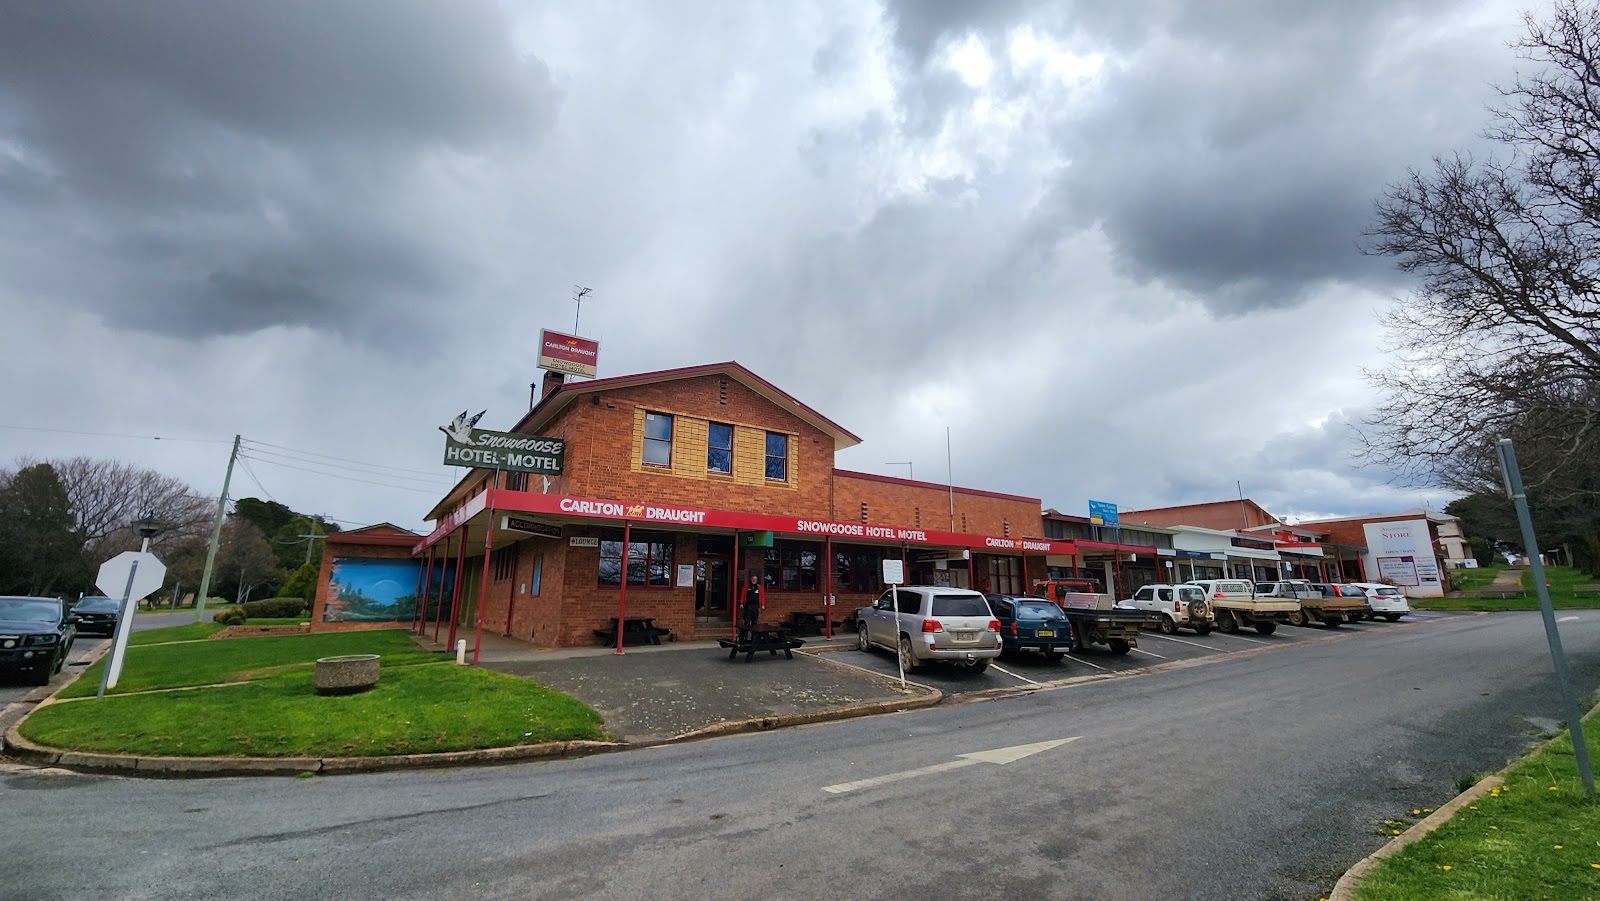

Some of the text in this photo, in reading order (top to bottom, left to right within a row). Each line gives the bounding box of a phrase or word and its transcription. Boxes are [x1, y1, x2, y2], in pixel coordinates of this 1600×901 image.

[545, 341, 570, 352] CARLTON
[570, 347, 596, 357] DRAUGHT
[550, 362, 585, 374] HOTEL MOTEL
[552, 358, 585, 369] SNOWGOOSE
[476, 433, 563, 455] SNOWGOOSE
[560, 498, 706, 523] CARLTON DRAUGHT
[510, 519, 560, 535] ACCOMMODATION
[797, 520, 927, 541] SNOWGOOSE HOTEL MOTEL
[575, 538, 598, 546] LOUNGE
[985, 537, 1051, 551] CARLTON DRAUGHT
